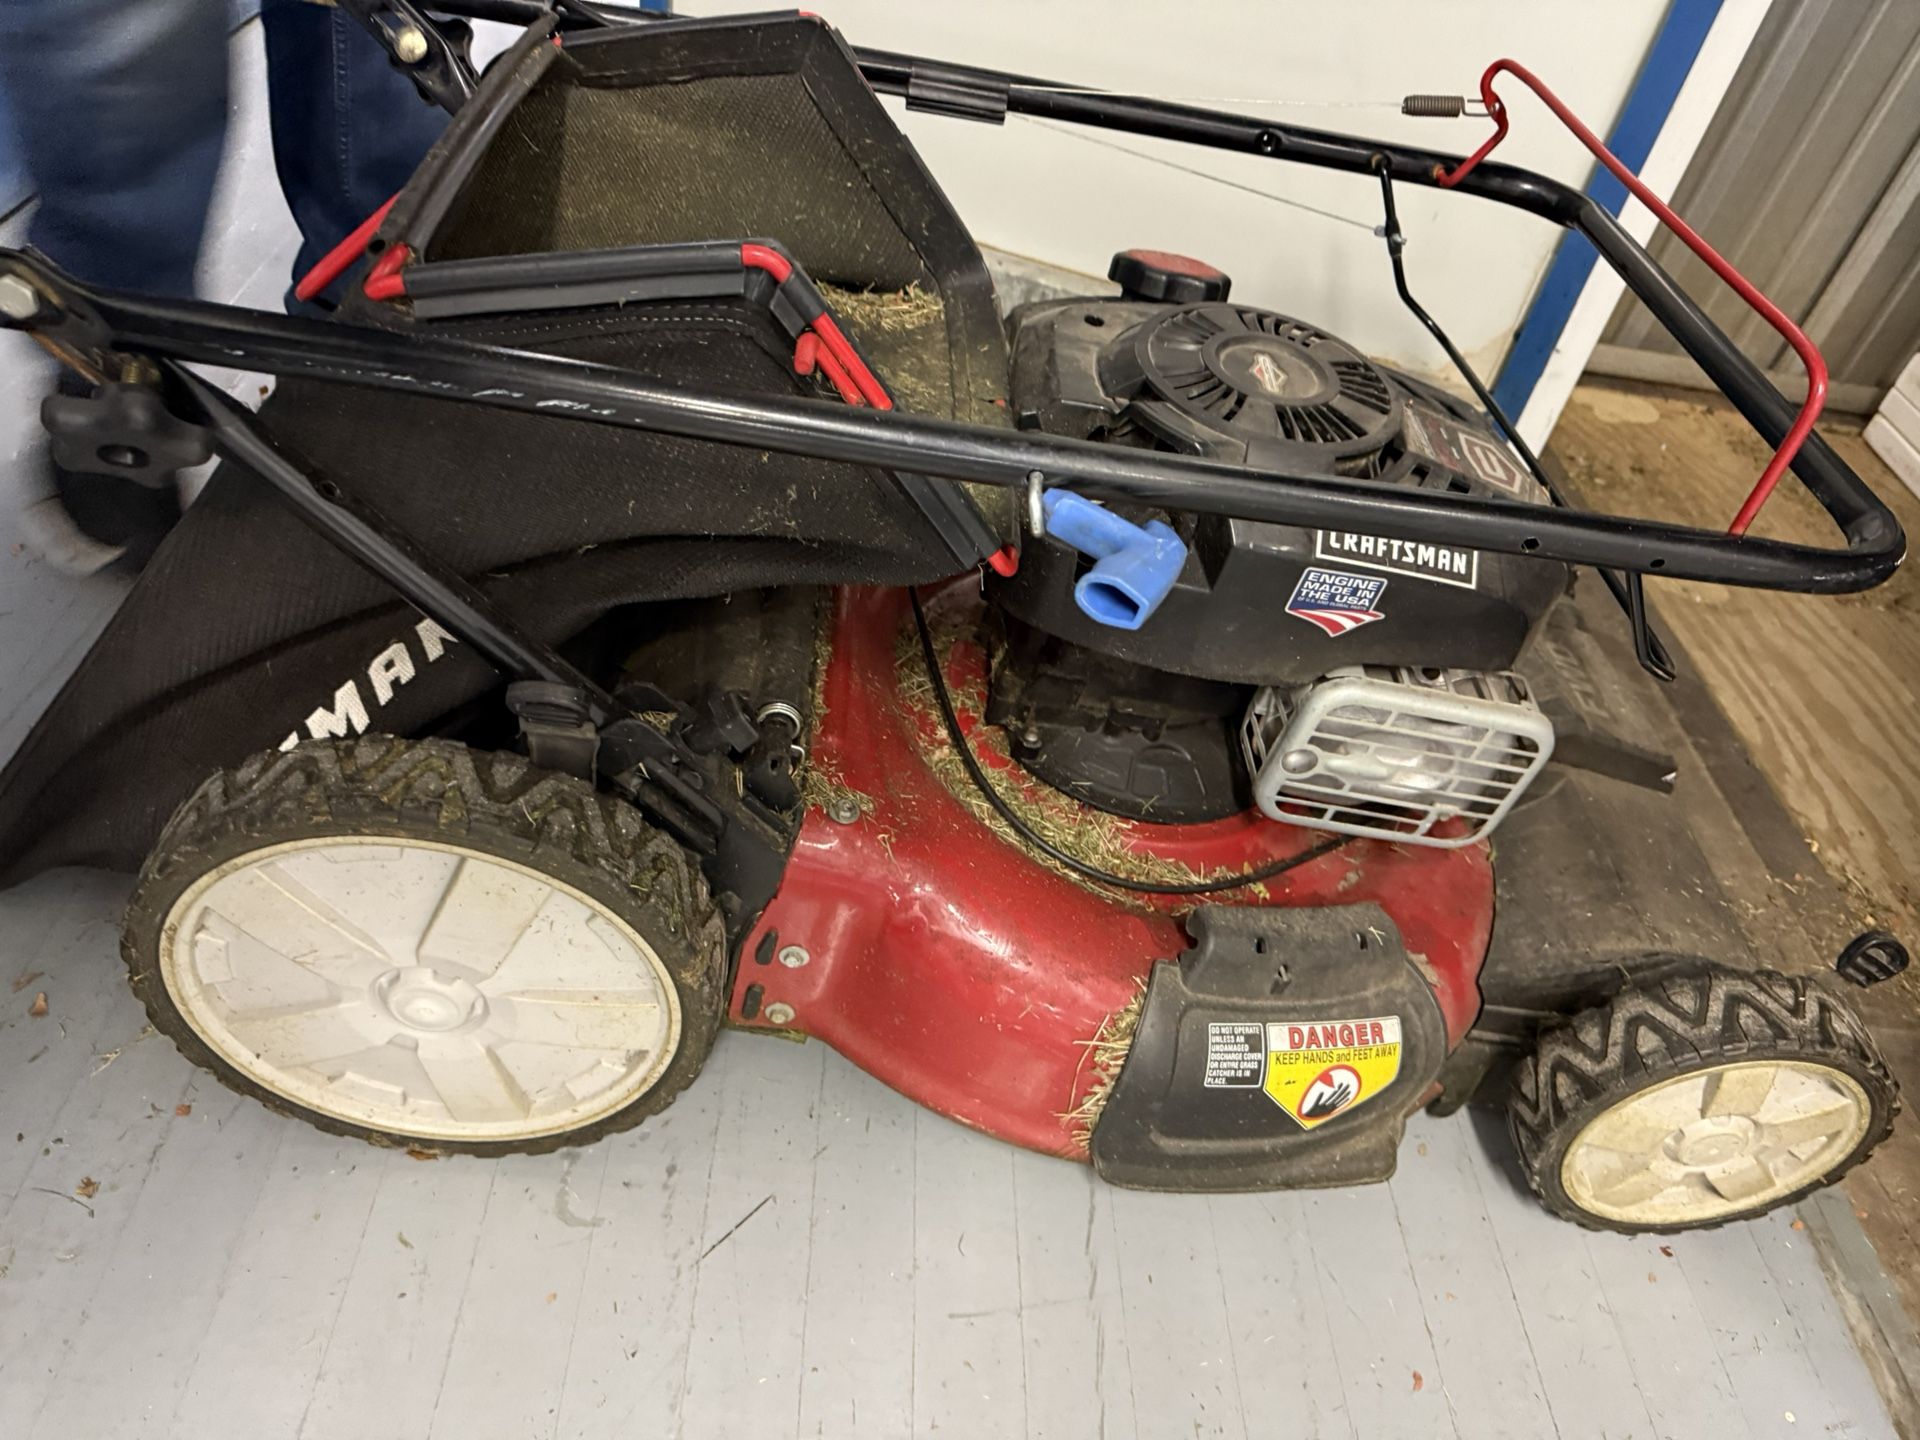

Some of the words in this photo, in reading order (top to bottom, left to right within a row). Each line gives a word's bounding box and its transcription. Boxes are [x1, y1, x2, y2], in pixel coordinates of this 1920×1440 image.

[1329, 531, 1467, 575] CRAFTSMAN
[1303, 581, 1353, 596] MADE
[1356, 589, 1375, 600] IN
[1308, 572, 1380, 591] ENGINE
[1300, 588, 1331, 601] THE
[1334, 594, 1370, 607] USA
[1211, 1026, 1220, 1034] DO
[1220, 1026, 1233, 1034] NOT
[1233, 1026, 1260, 1035] OPERATE
[1211, 1035, 1235, 1043] UNLESS
[1236, 1035, 1245, 1043] AN
[1288, 1022, 1385, 1049] DANGER
[1211, 1044, 1250, 1052] UNDAMAGED
[1275, 1052, 1301, 1065] KEEP
[1303, 1051, 1334, 1064] HANDS
[1335, 1051, 1351, 1062] and
[1353, 1048, 1373, 1060] FEET
[1374, 1045, 1397, 1058] AWAY
[1210, 1061, 1219, 1069] OR
[1219, 1061, 1239, 1069] ENTIRE
[1239, 1061, 1259, 1069] GRASS
